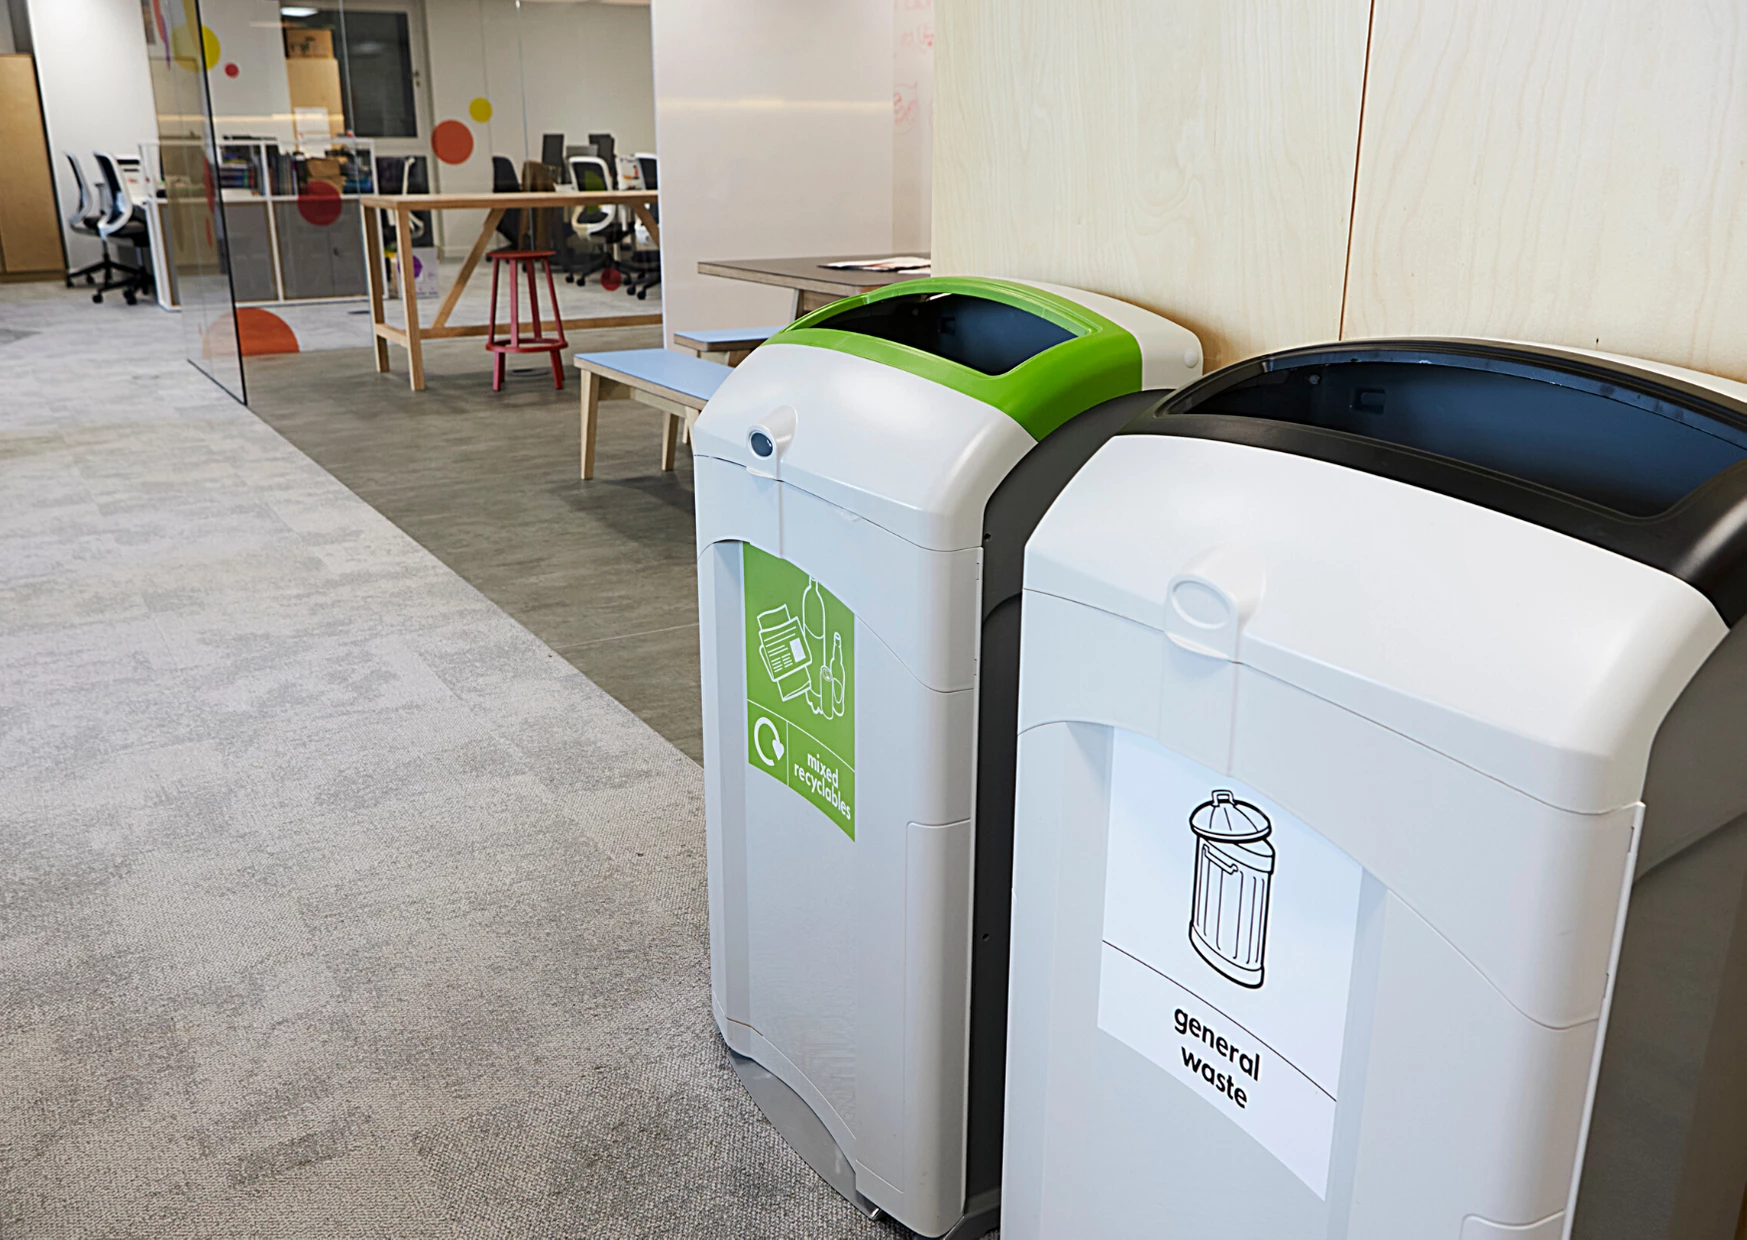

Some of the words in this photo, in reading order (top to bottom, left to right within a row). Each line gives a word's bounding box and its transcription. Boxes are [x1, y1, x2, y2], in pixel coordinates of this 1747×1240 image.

[794, 763, 851, 820] recyclables
[807, 753, 838, 788] mixed
[1174, 1008, 1260, 1081] general
[1181, 1046, 1247, 1109] waste
